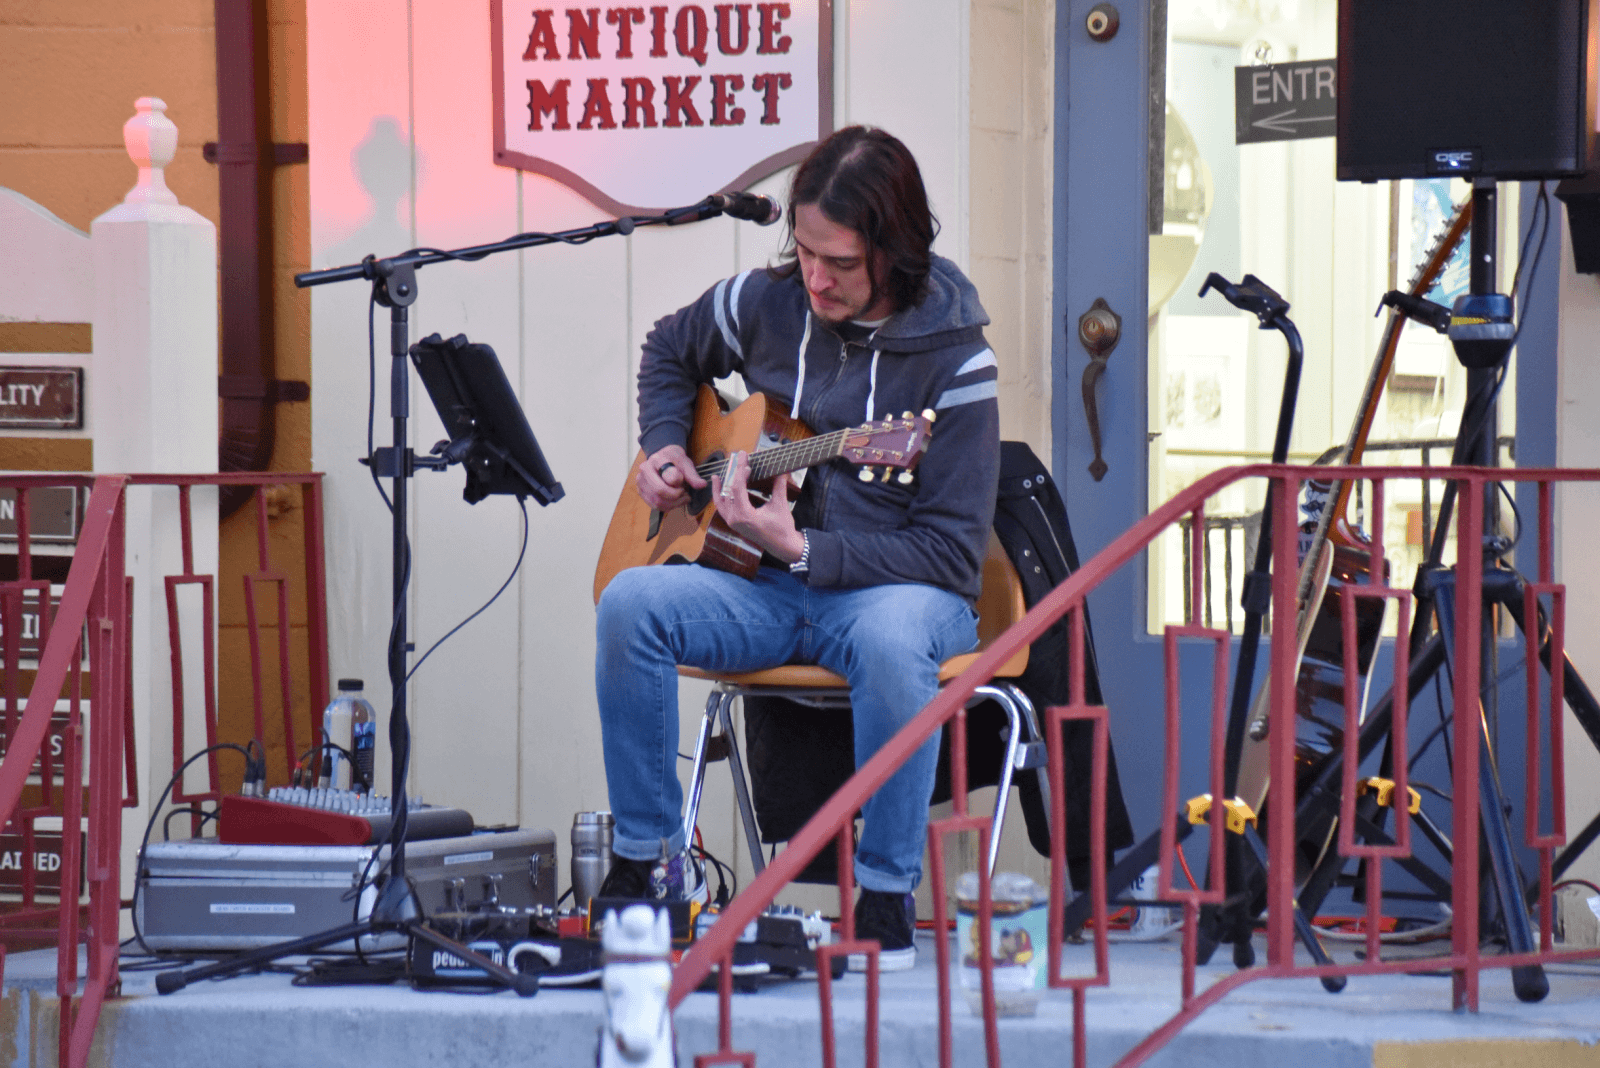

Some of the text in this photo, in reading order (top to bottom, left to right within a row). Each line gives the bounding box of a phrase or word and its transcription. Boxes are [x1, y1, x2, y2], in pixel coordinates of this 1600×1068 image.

[522, 2, 793, 67] ANTIQUE
[526, 72, 793, 131] MARKET
[1435, 151, 1473, 163] QSC
